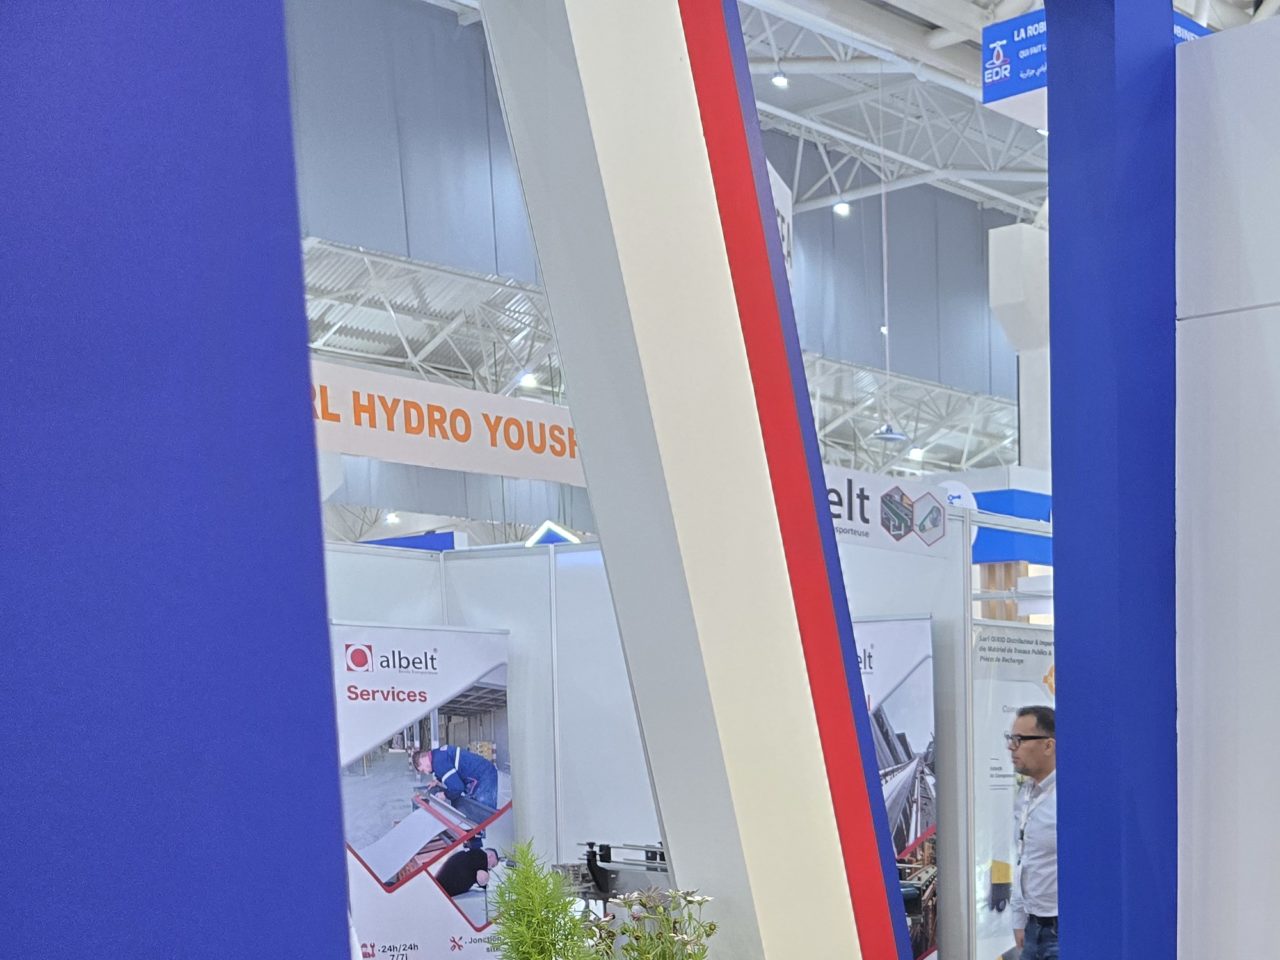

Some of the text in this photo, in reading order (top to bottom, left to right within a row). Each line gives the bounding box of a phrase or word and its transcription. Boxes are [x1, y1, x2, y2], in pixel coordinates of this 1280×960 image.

[1014, 28, 1026, 42] LA
[984, 64, 1010, 83] EDR
[352, 390, 472, 443] HYDRO
[379, 649, 438, 671] albelt
[346, 684, 428, 703] Services
